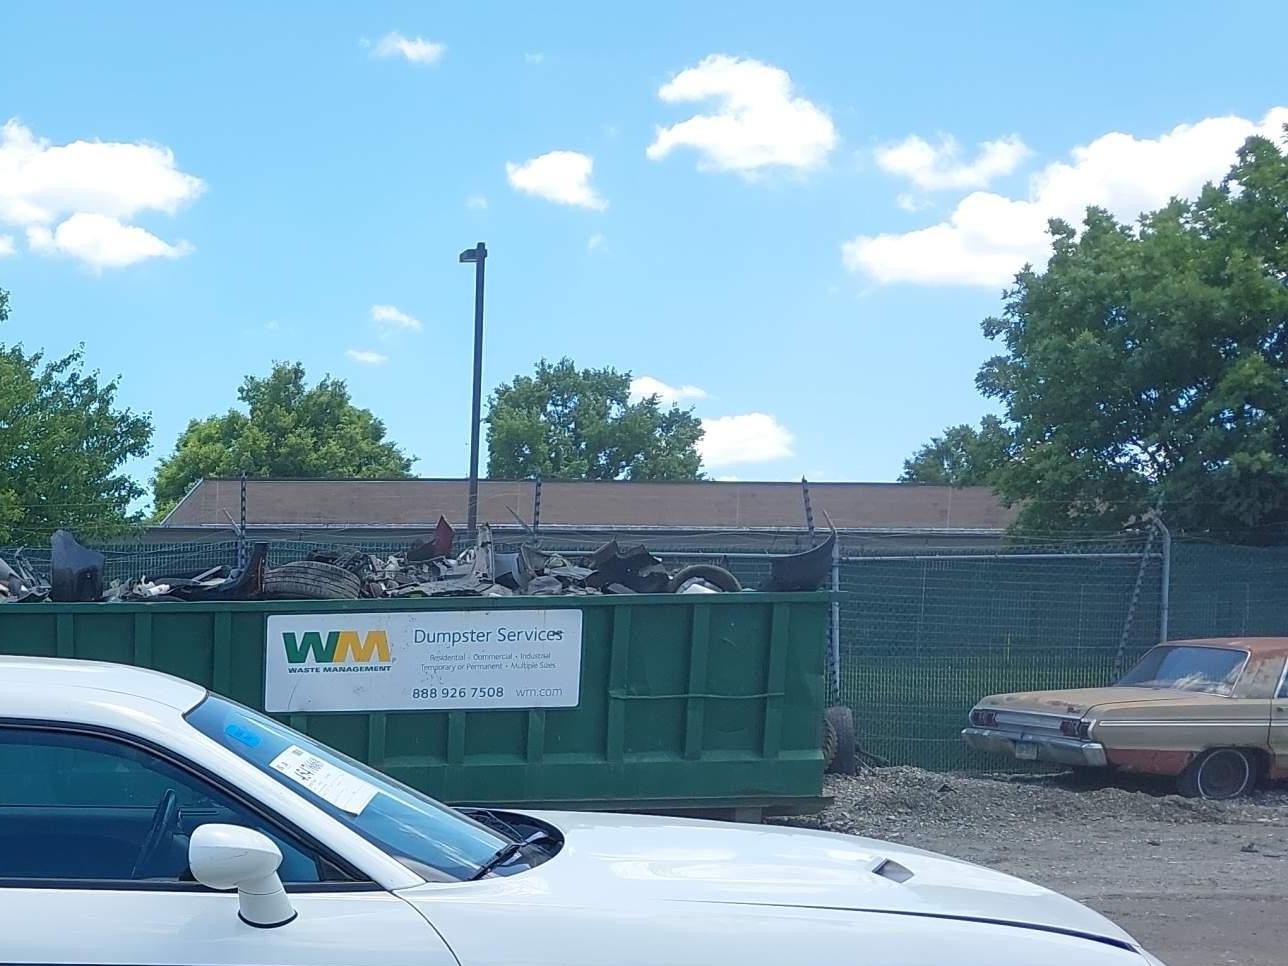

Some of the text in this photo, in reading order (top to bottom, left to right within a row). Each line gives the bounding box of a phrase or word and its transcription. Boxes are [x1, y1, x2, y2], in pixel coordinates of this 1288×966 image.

[414, 627, 562, 646] Dumpster Services
[282, 631, 391, 663] WM
[429, 652, 551, 661] Residential Commercial Industrial
[421, 663, 456, 672] Temporary
[466, 662, 503, 671] Permanent
[512, 661, 538, 669] Multiple
[412, 686, 504, 699] 888 926 7508
[516, 687, 563, 697] wm.com
